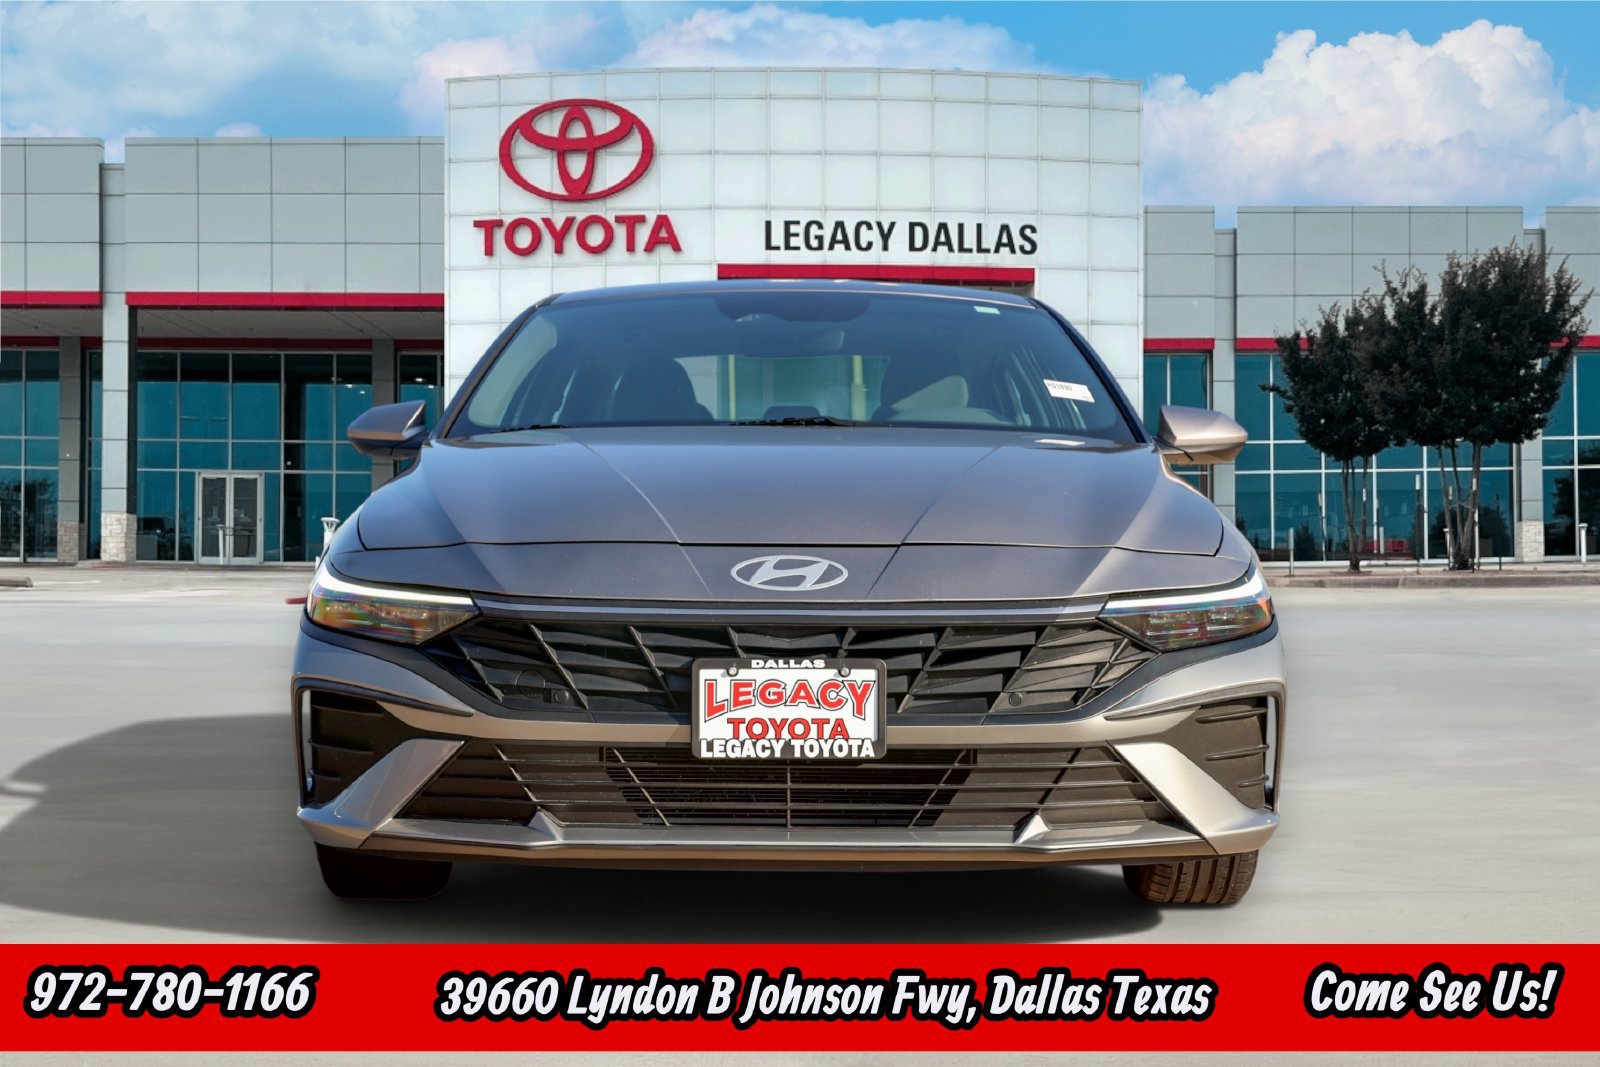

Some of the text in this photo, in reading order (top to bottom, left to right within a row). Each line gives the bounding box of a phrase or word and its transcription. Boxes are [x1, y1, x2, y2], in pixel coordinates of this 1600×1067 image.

[474, 214, 682, 257] TOYOTA
[764, 220, 1038, 255] LEGACY DALLAS
[751, 659, 826, 669] DALLAS
[704, 679, 876, 722] LEGACY
[726, 717, 850, 740] TOYOTA
[700, 739, 875, 758] LEGACY TOYOTA
